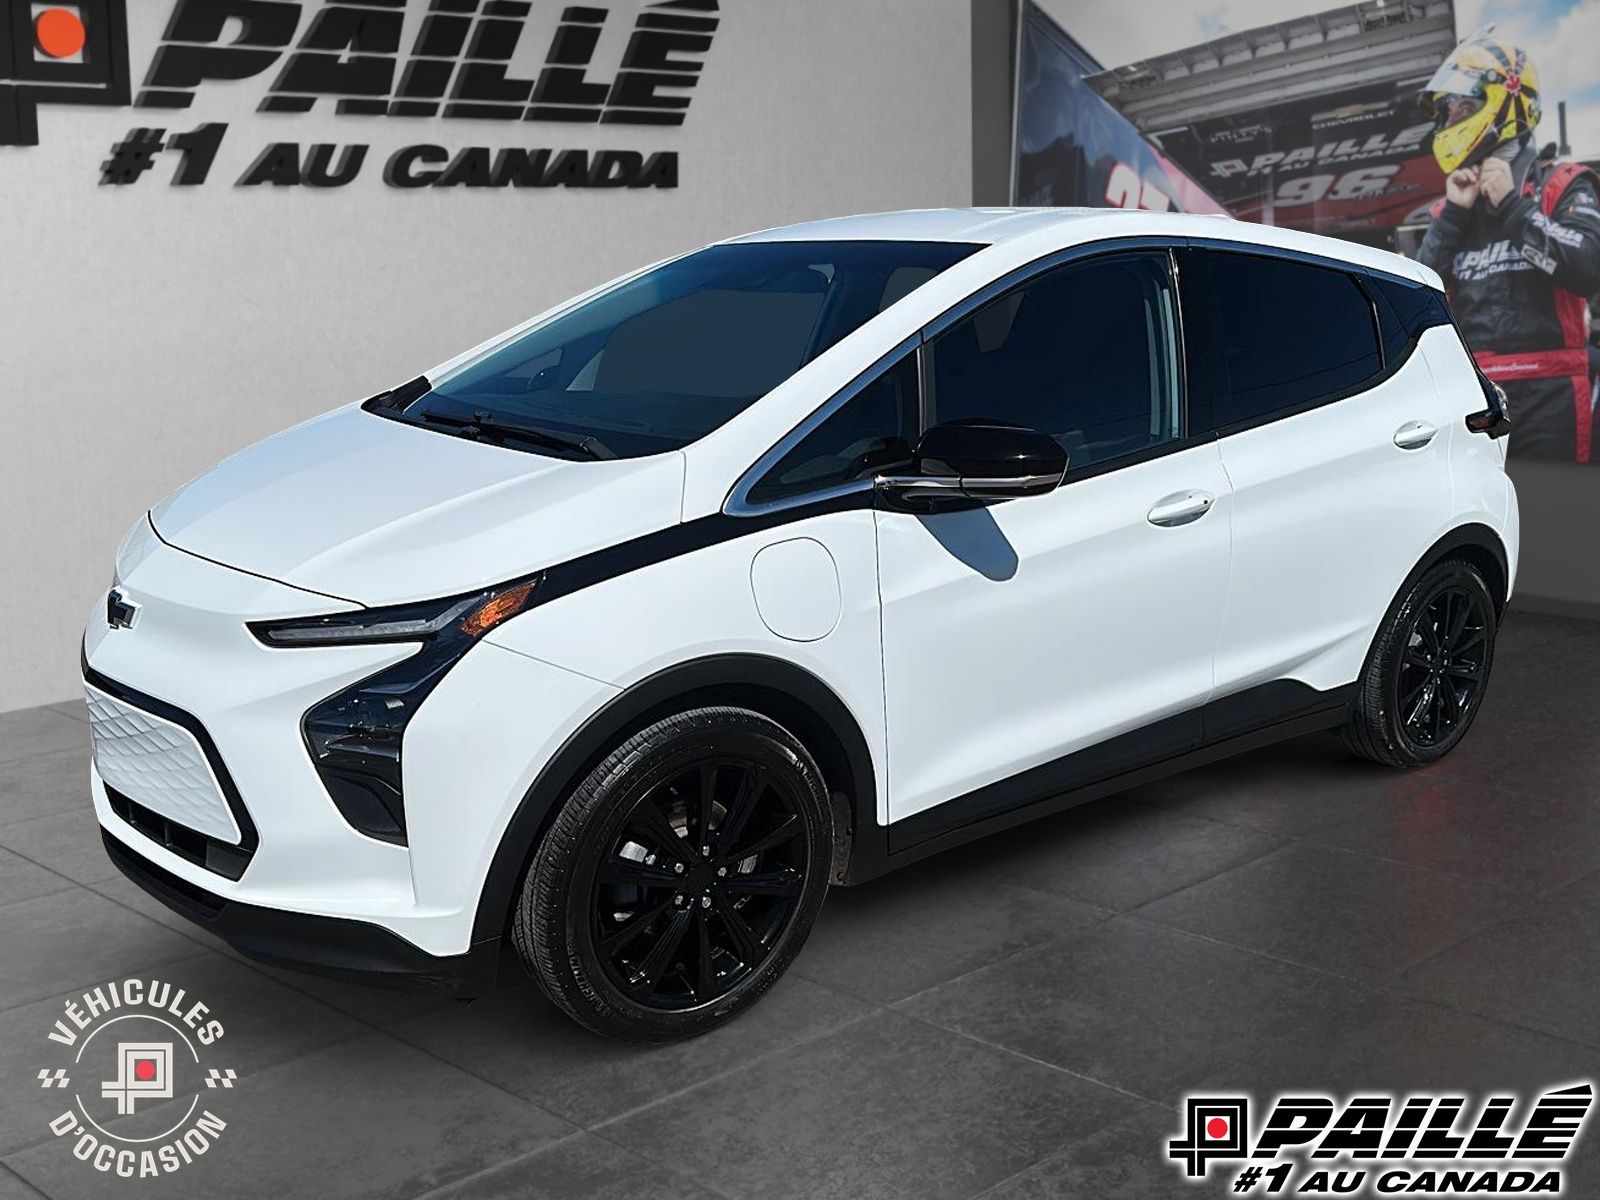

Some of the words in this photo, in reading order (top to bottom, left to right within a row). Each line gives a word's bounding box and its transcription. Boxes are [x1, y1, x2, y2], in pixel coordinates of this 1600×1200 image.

[133, 0, 720, 126] PAILLÉ
[98, 122, 230, 186] #1
[233, 143, 370, 187] AU
[382, 144, 679, 188] CANADA
[1274, 164, 1401, 207] 96
